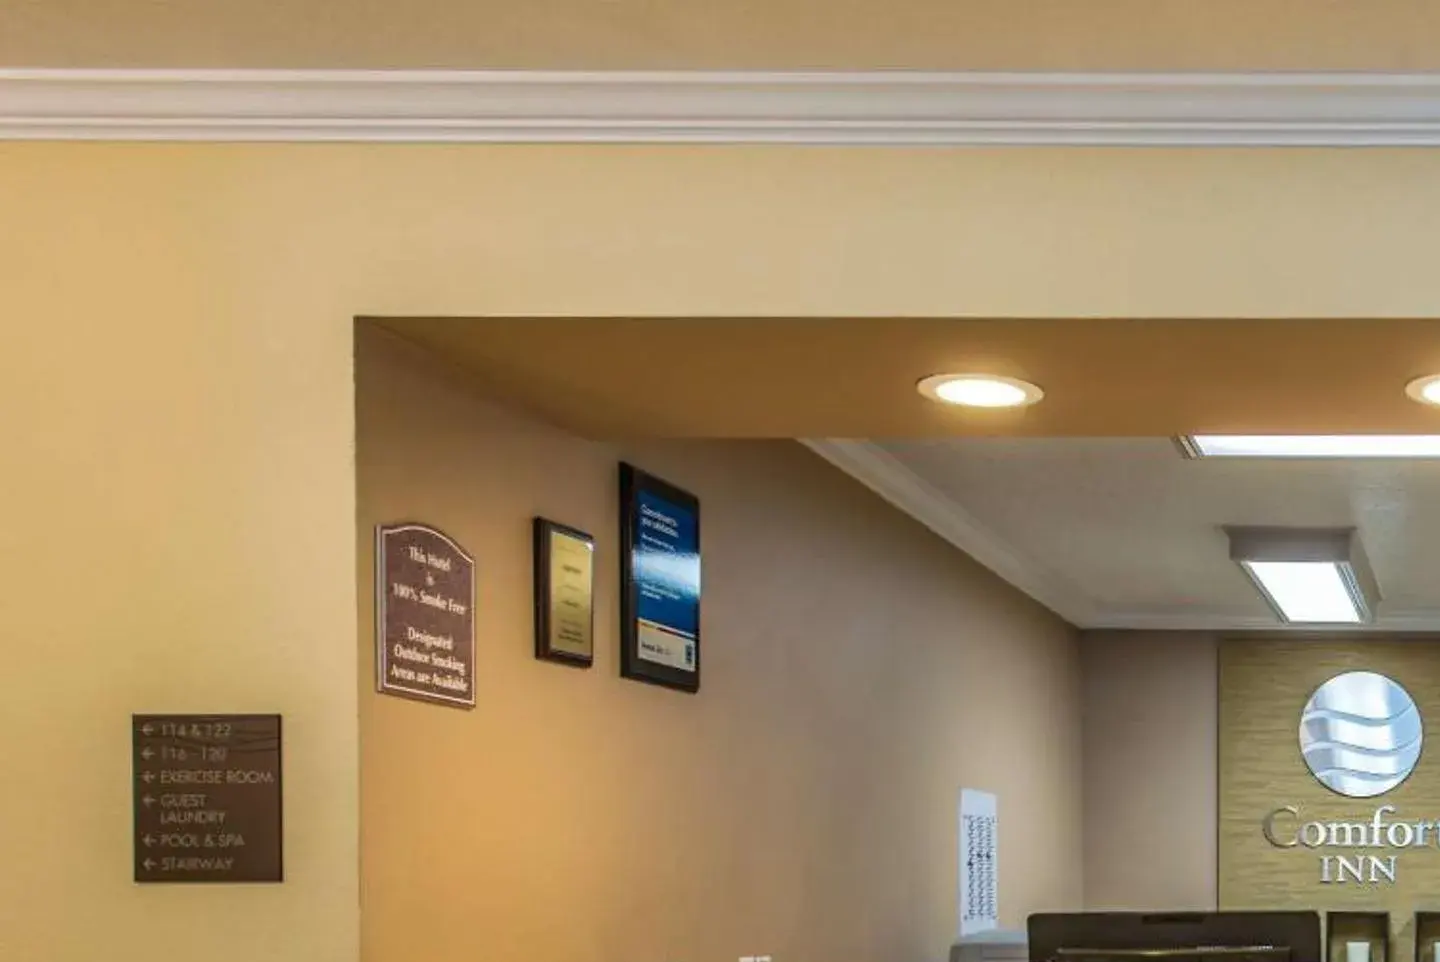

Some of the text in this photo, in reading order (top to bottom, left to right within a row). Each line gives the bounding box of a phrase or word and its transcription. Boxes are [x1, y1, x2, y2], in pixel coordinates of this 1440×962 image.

[408, 545, 427, 564] This
[393, 582, 467, 616] 100% Smoke Free
[407, 626, 454, 651] Designated
[394, 643, 466, 677] Outdoor Smoking
[390, 664, 469, 693] Areas are Available
[160, 769, 274, 784] EXERCISE ROOM
[160, 793, 207, 808] GUEST
[160, 810, 226, 825] LAUNDRY
[160, 833, 200, 848] POOL
[217, 833, 246, 848] SPA
[160, 856, 235, 872] STAIRWAY
[1319, 854, 1398, 884] INN
